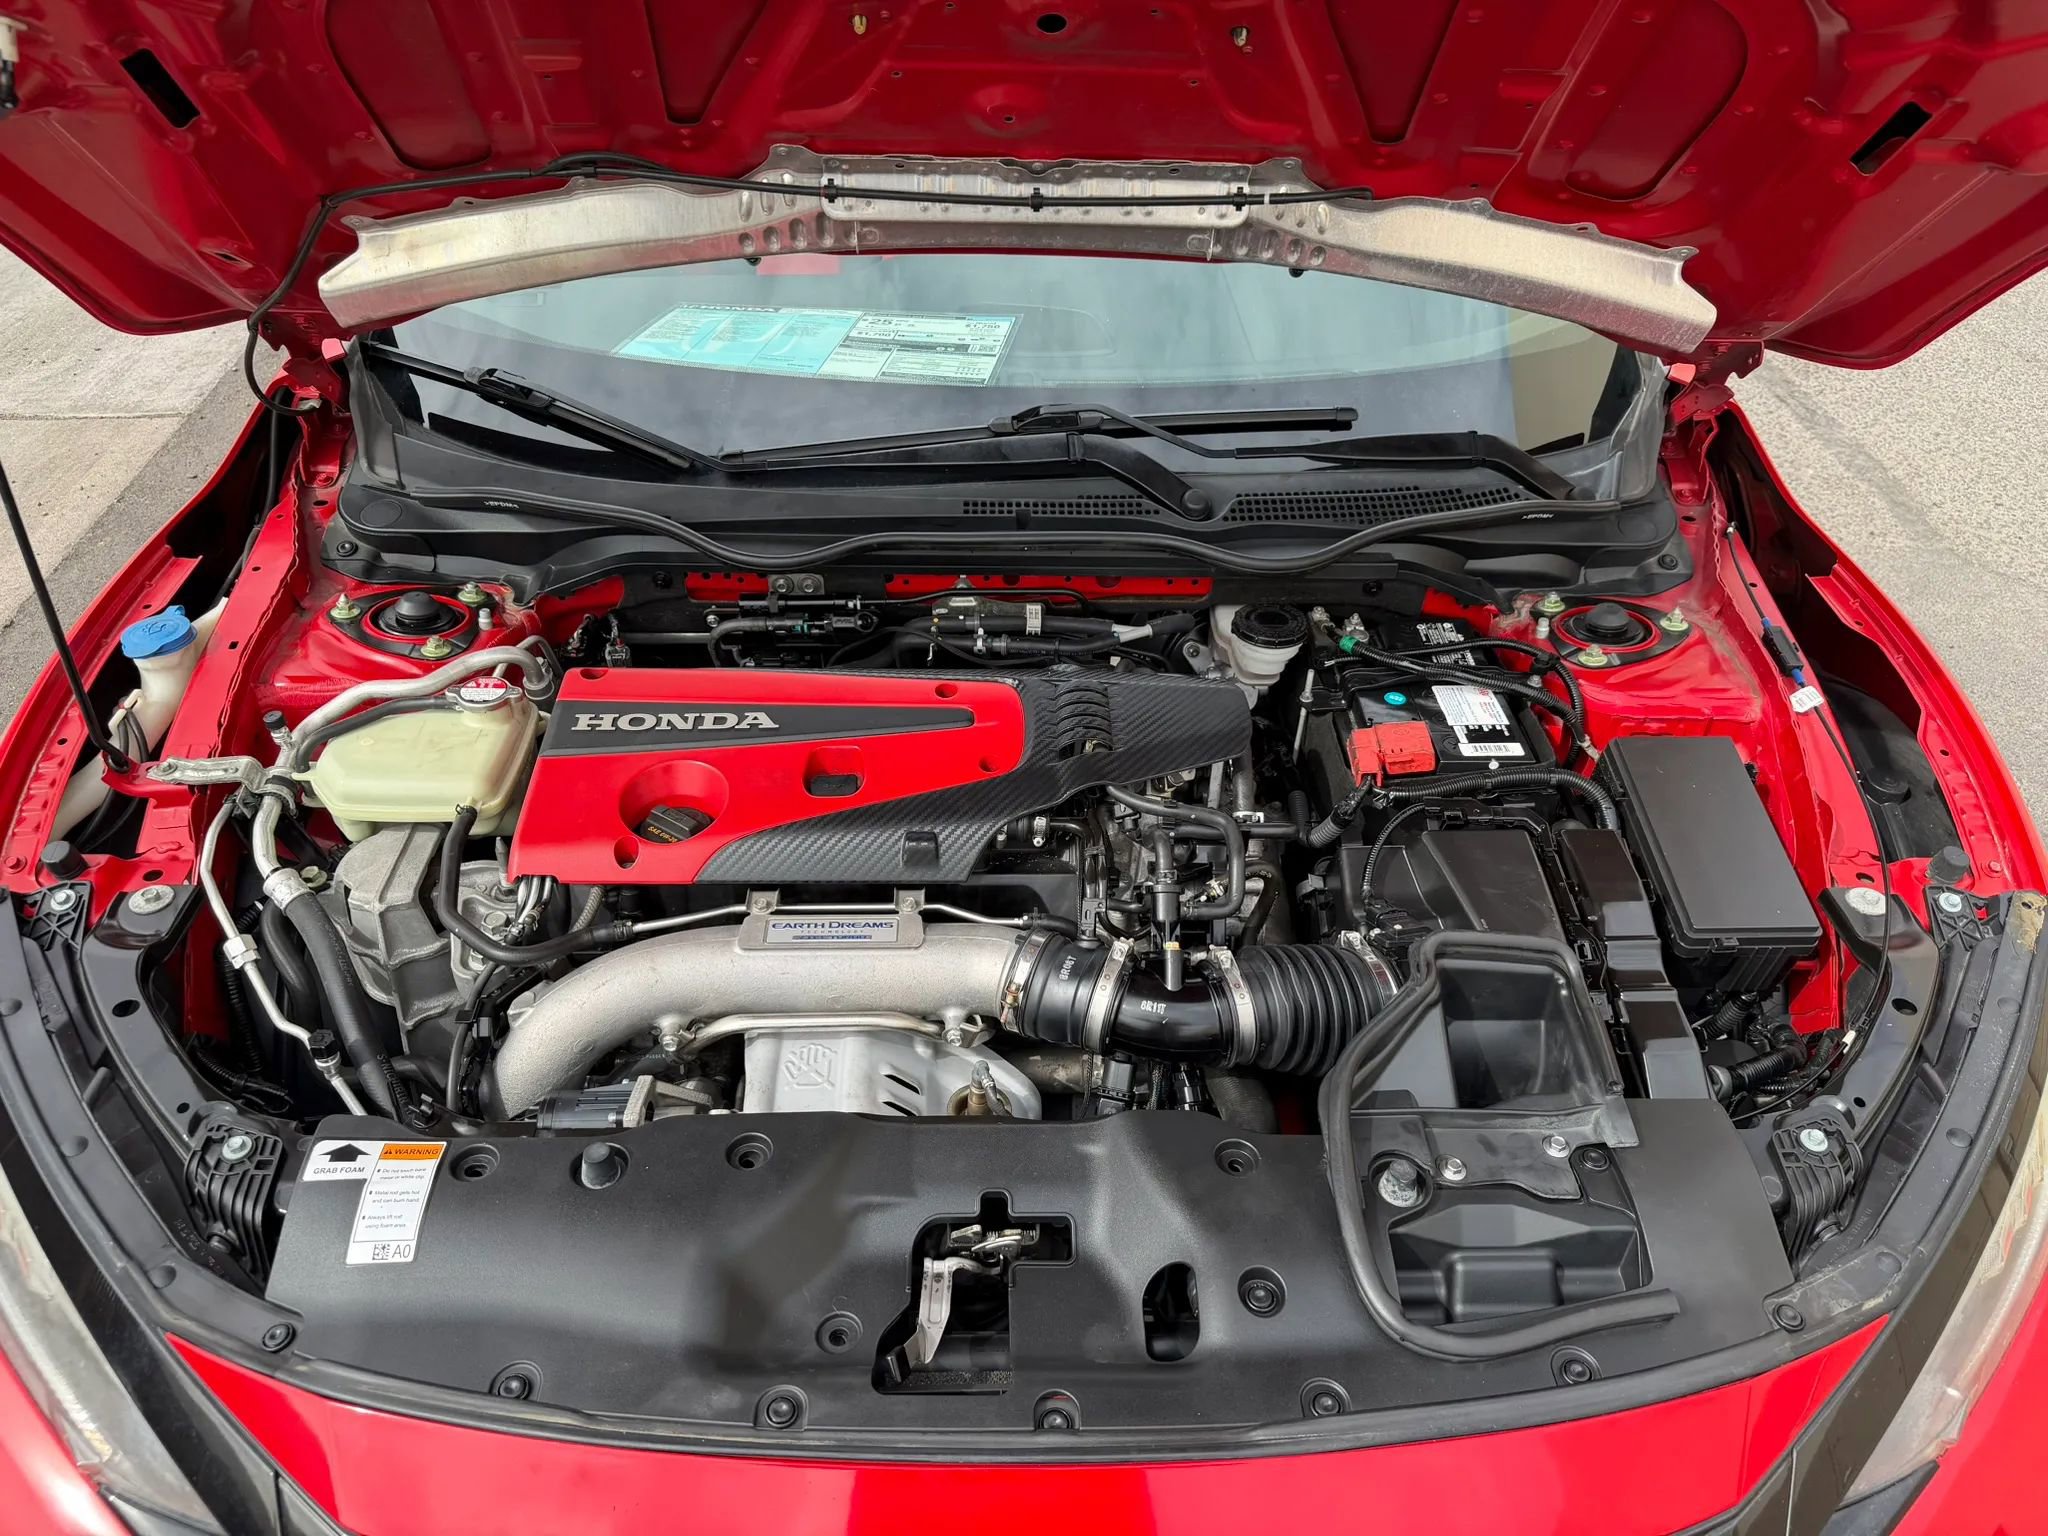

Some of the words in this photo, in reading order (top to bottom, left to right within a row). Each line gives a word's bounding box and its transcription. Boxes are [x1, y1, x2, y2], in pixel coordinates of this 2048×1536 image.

[571, 711, 780, 731] HONDA
[772, 921, 826, 929] EARTH
[828, 921, 894, 929] DREAMS
[313, 1167, 338, 1175] GRAB
[339, 1166, 365, 1174] FOAM
[391, 1244, 412, 1259] A0
